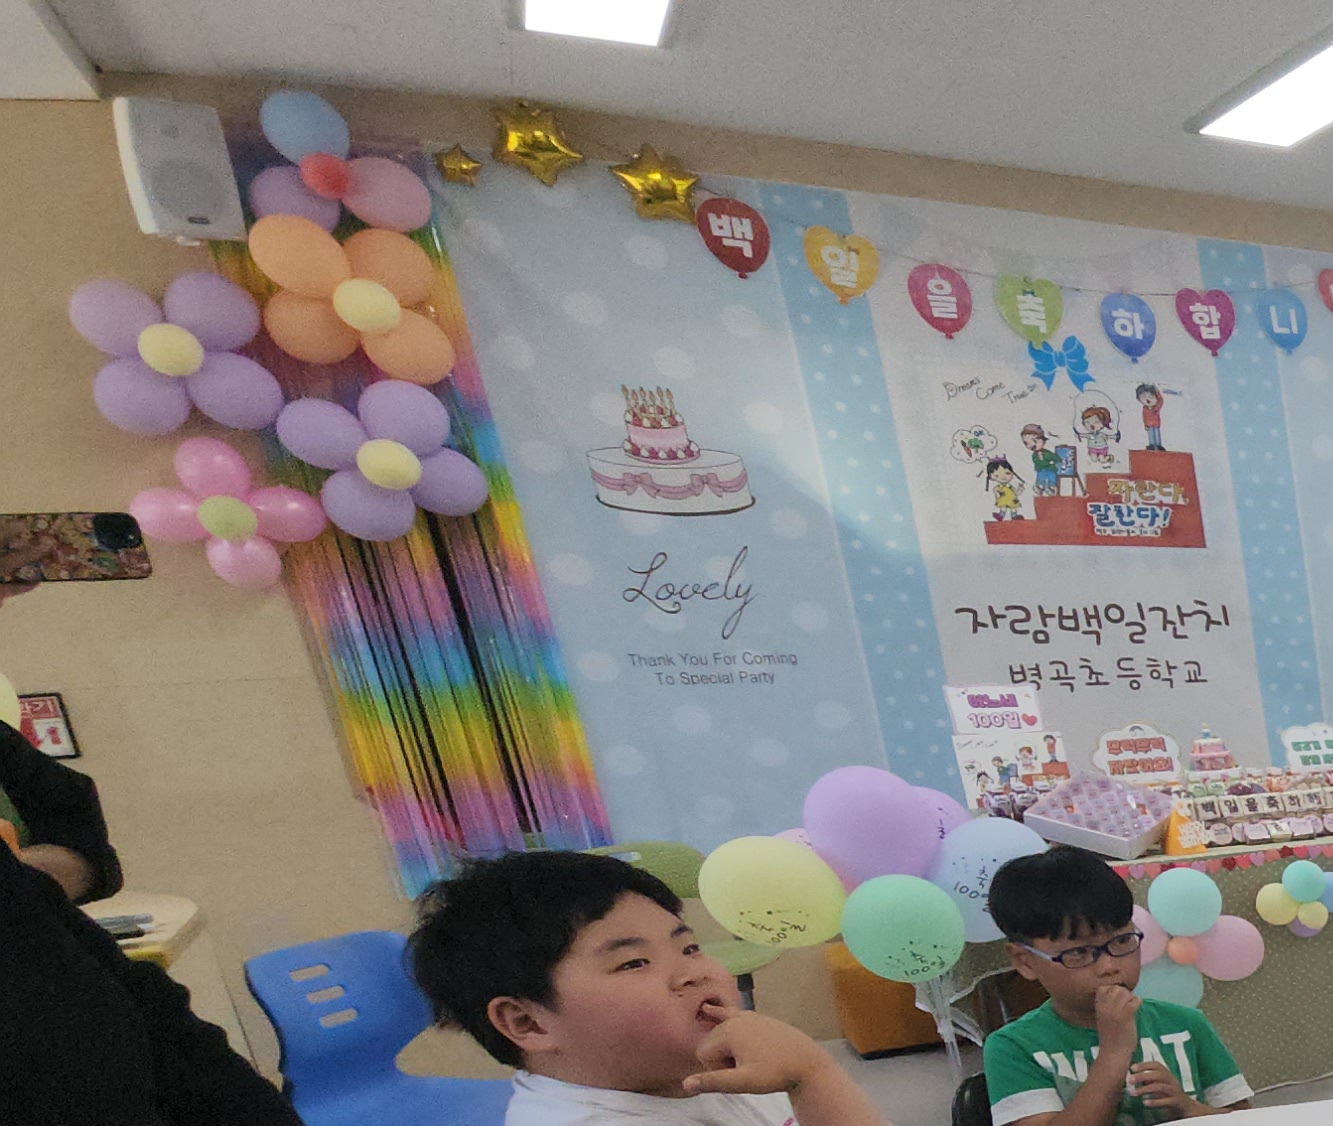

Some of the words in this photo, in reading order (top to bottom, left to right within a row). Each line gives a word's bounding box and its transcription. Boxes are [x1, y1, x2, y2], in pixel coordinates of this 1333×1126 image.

[710, 212, 754, 258] 백
[821, 244, 860, 288] 일
[927, 278, 959, 320] 을
[1111, 308, 1146, 340] 하
[1190, 303, 1221, 340] 합
[1271, 305, 1300, 335] 니
[622, 545, 758, 640] Lovely
[955, 599, 1230, 646] 자람백일잔치
[628, 653, 675, 668] Thank
[679, 652, 708, 667] You
[713, 652, 737, 666] For
[742, 651, 798, 667] Coming
[656, 672, 675, 686] To
[680, 671, 734, 686] Special
[739, 670, 775, 685] Party
[1009, 657, 1208, 693] 벽곡초등학교
[966, 711, 1022, 729] 100일
[1032, 1030, 1196, 1096] WAT
